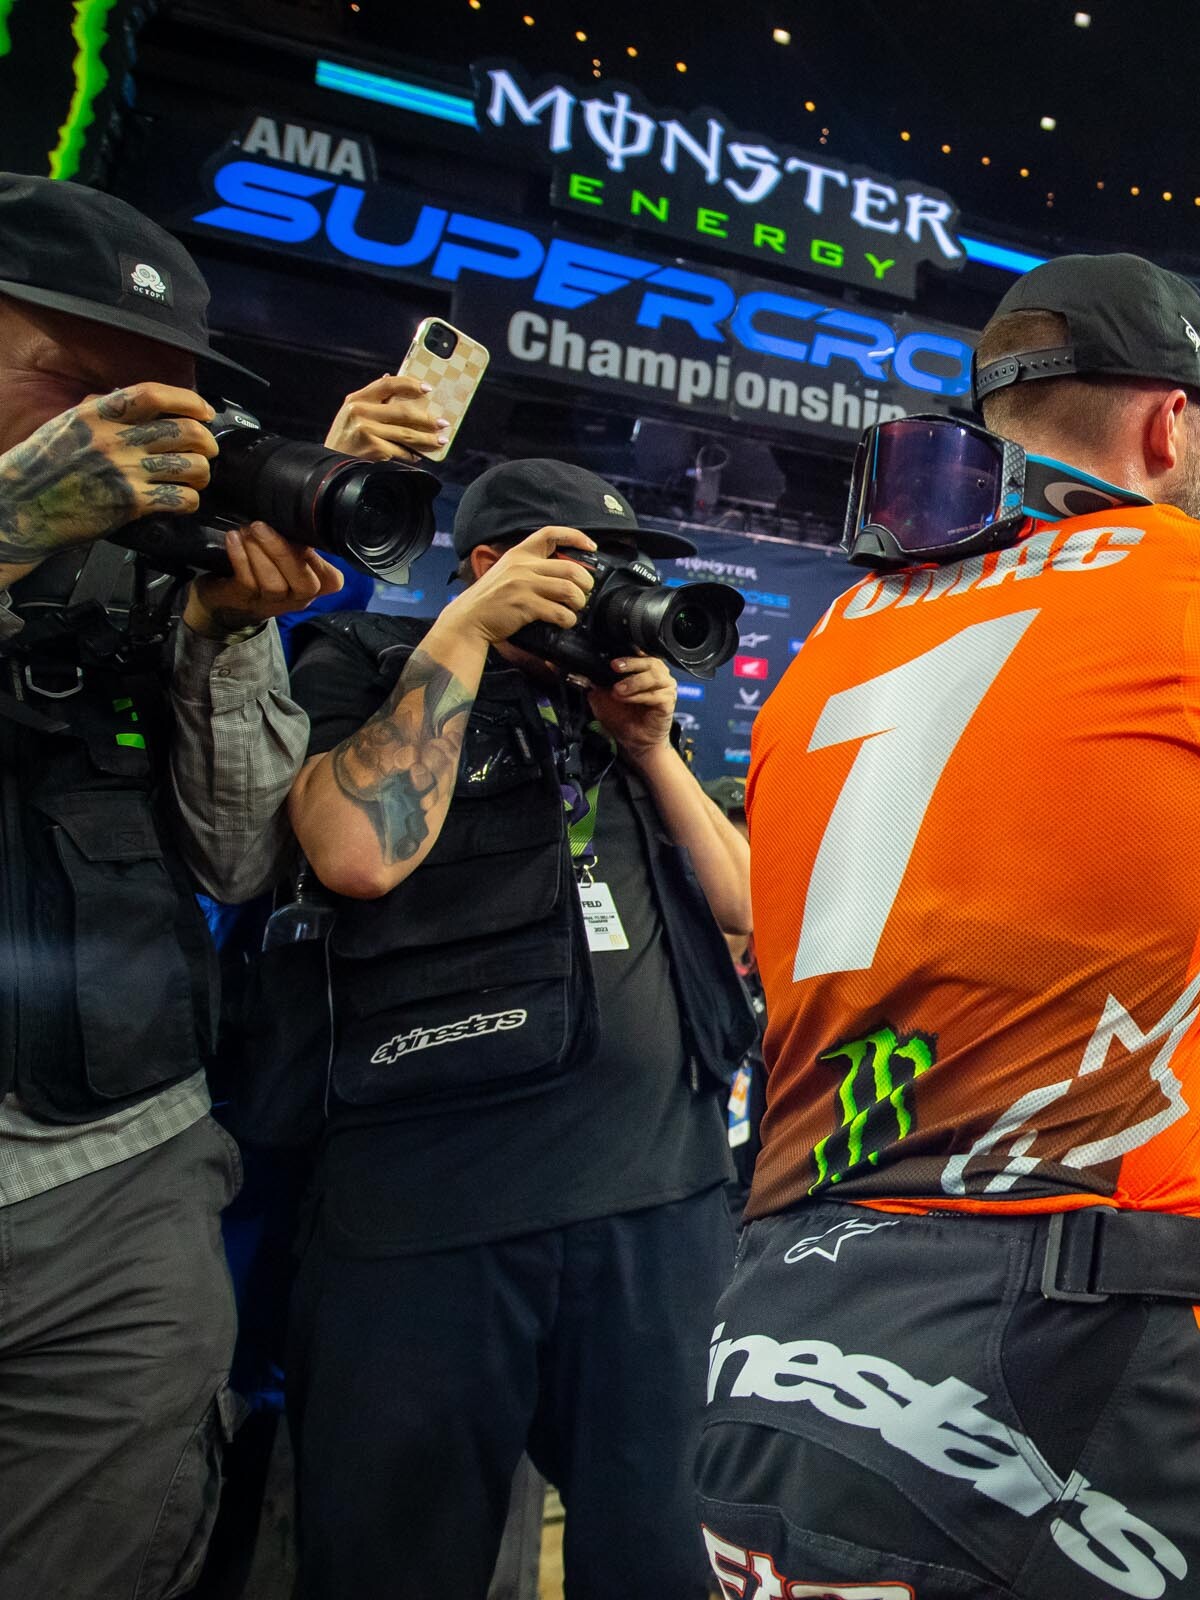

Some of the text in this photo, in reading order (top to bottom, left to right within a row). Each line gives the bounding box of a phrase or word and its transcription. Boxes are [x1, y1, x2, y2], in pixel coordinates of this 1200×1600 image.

[241, 116, 367, 182] AMA
[487, 69, 962, 259] MONSTER
[569, 173, 896, 281] ENERGY
[632, 563, 657, 582] Nikon
[793, 607, 1042, 983] 1
[371, 1009, 527, 1064] alpinestars
